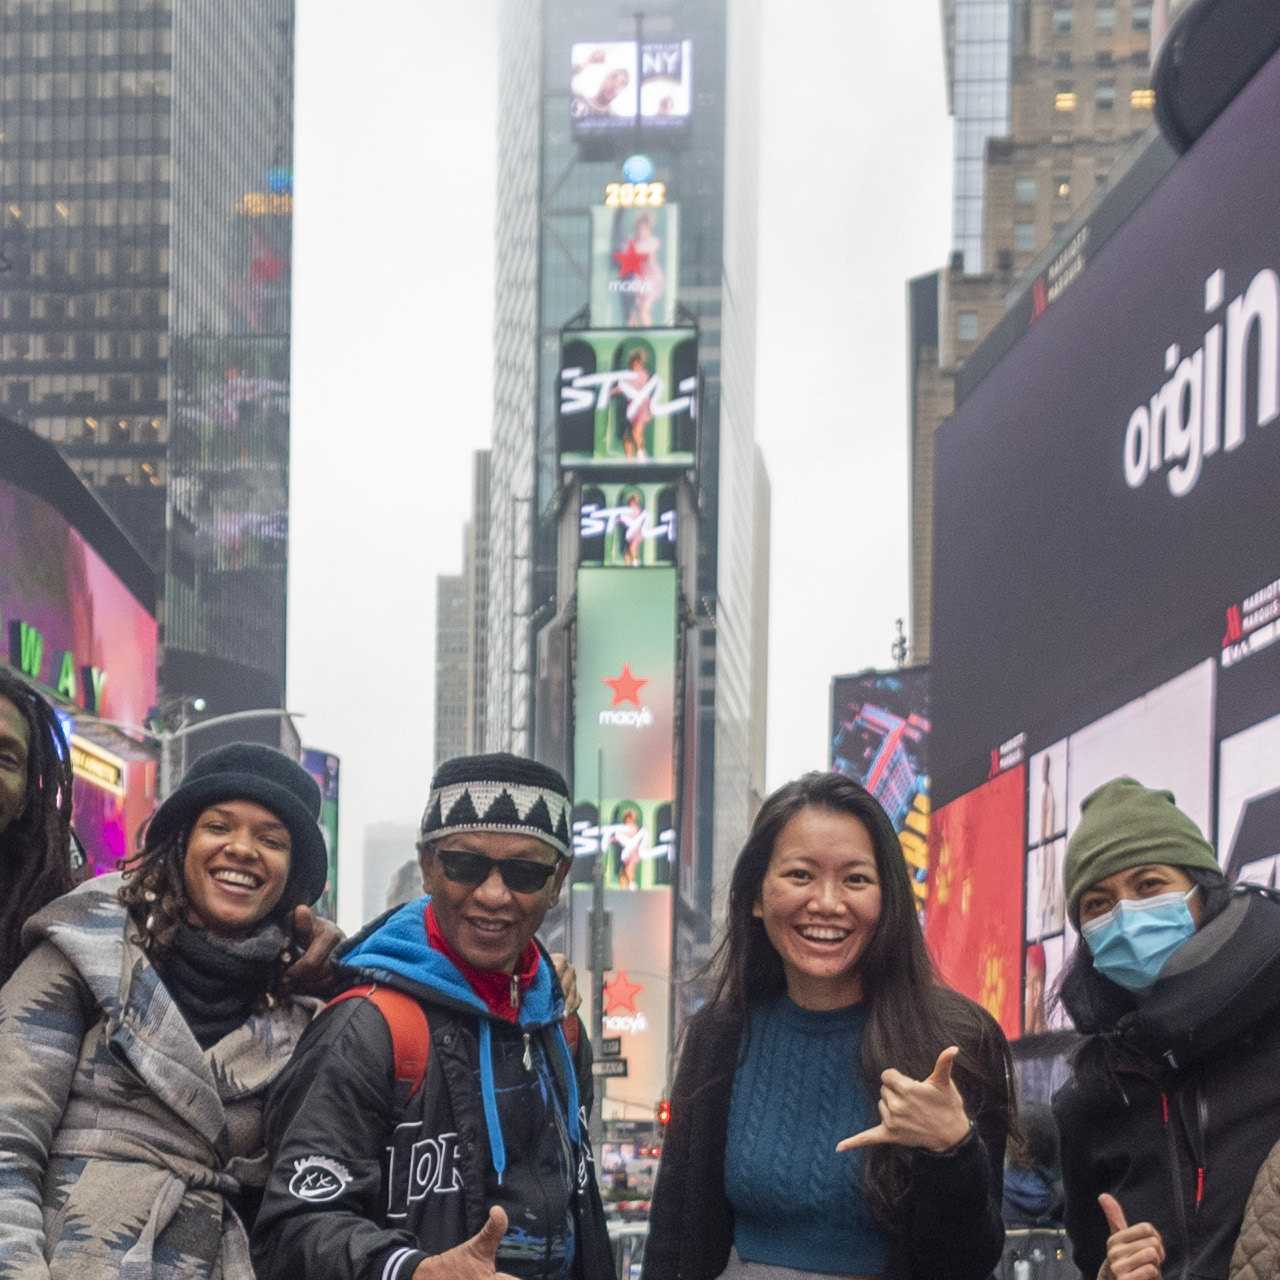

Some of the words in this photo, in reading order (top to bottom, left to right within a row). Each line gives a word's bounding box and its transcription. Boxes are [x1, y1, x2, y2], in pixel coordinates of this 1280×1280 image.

[642, 51, 679, 74] NY
[605, 182, 666, 207] 2022
[598, 706, 653, 729] macy's
